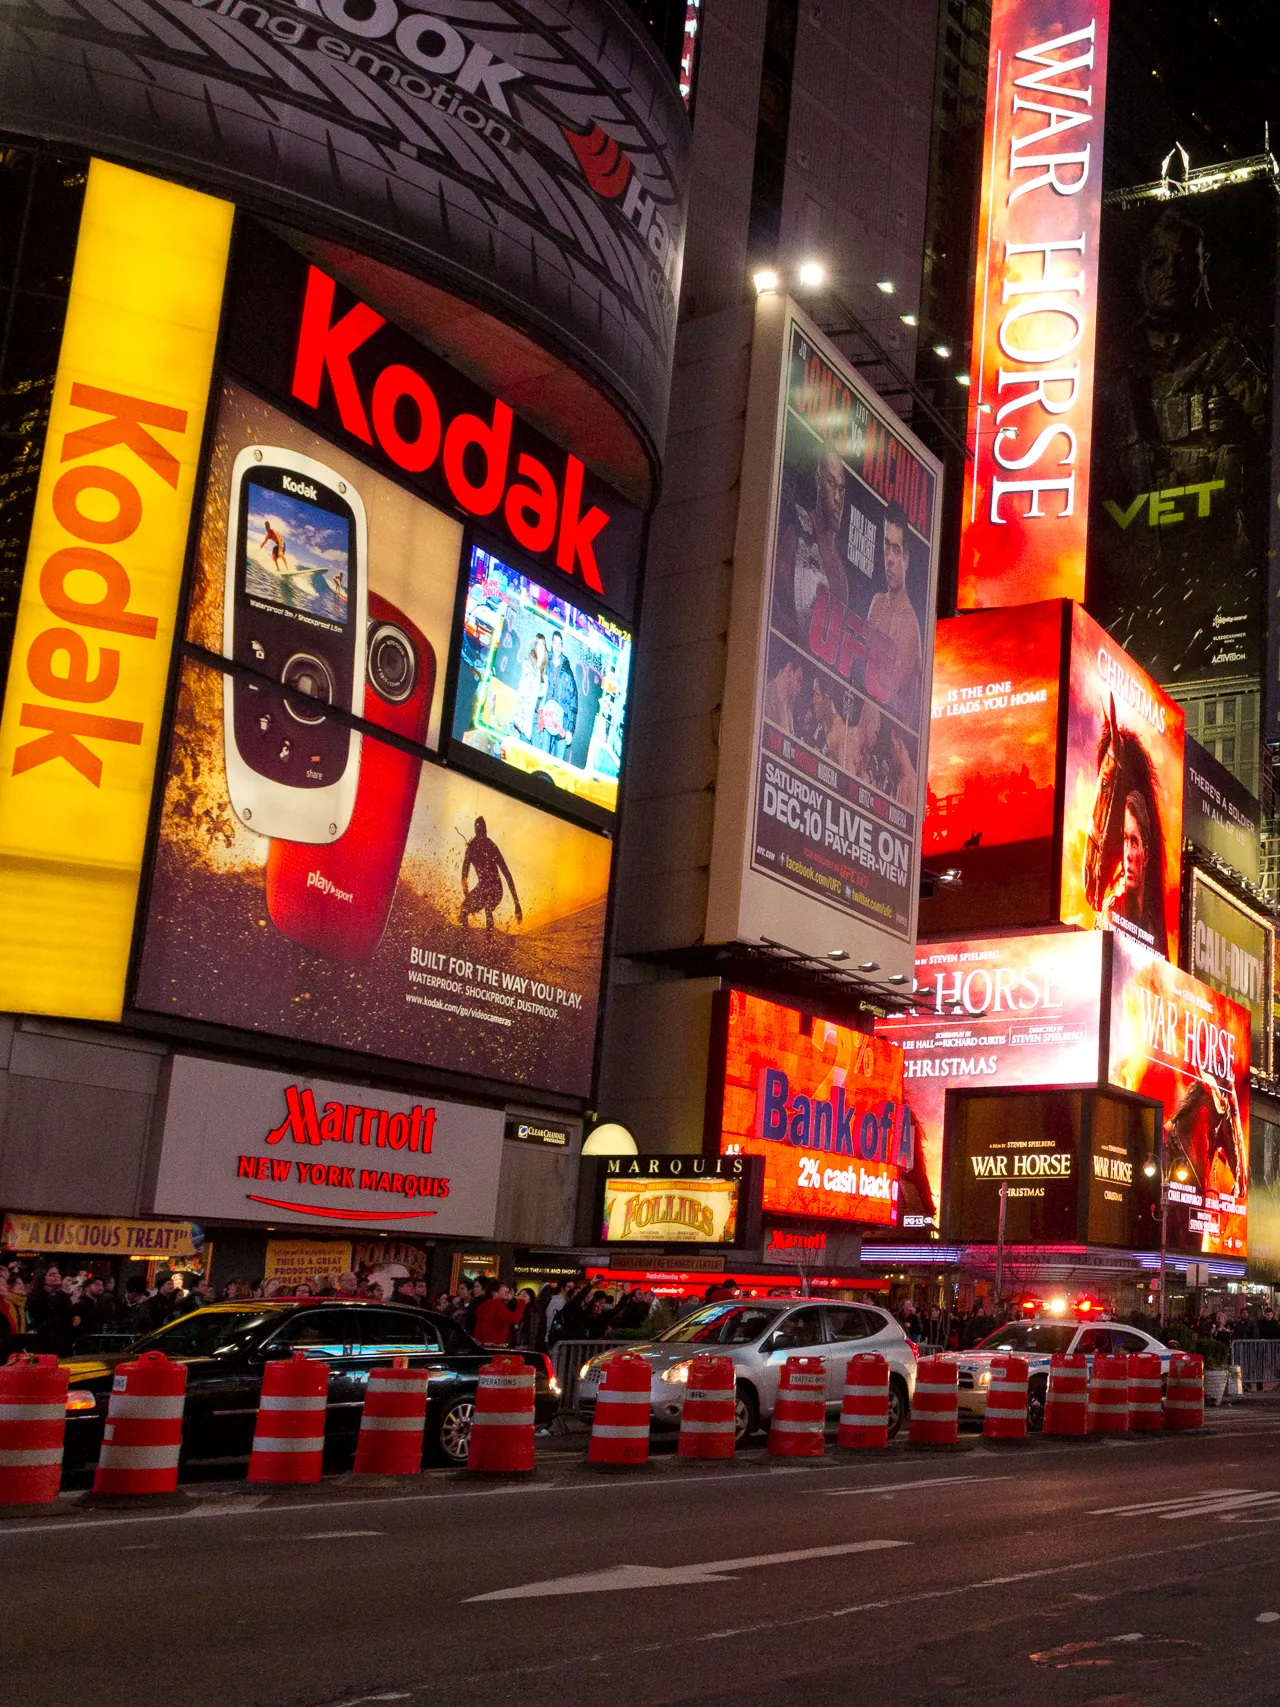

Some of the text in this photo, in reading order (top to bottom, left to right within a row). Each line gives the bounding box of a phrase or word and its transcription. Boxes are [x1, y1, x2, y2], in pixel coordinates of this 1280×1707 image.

[316, 33, 513, 148] emotion
[989, 17, 1097, 524] WAR HORSE
[291, 263, 611, 596] Kodak
[282, 475, 319, 501] Kodak
[1103, 479, 1226, 530] VET
[11, 381, 189, 789] Kodak
[808, 582, 898, 704] UFC
[946, 689, 1047, 717] LEADS YOU HOME
[947, 680, 1012, 702] IS THE ONE
[1097, 648, 1166, 734] CHRISTMAS
[306, 767, 324, 781] share
[764, 761, 824, 812] SATURDAY
[762, 782, 822, 842] DEC.10
[1189, 767, 1256, 836] THERE'S A SOLDIER
[1202, 799, 1246, 847] IN ALL OF US
[825, 798, 873, 852] LIVE
[877, 830, 909, 873] ON
[785, 855, 842, 895] facebook.com/UFC
[824, 829, 908, 889] PAY-PER-VIEW
[306, 869, 354, 904] play sport
[929, 950, 1000, 965] STEVEN SPIELBERG
[1195, 919, 1228, 985] CALL
[407, 969, 560, 1020] WATERPROOF. SHOCKPROOF. DUSTPROOF.
[410, 946, 583, 1010] BUILT FOR THE WAY YOU PLAY.
[934, 965, 1064, 1016] HORSE
[405, 991, 512, 1027] www.kodak.com/go/videocameras
[915, 1039, 935, 1050] HALL
[943, 1037, 978, 1048] RICHARD
[978, 1035, 1006, 1046] CURTIS
[1011, 1034, 1042, 1044] STEVEN
[1139, 987, 1178, 1058] WAR
[1183, 1009, 1236, 1083] HORSE
[264, 1084, 437, 1154] Marriott
[762, 1066, 855, 1157] Bank
[859, 1100, 895, 1163] of
[606, 1159, 743, 1175] MARQUIS
[971, 1153, 1071, 1176] WAR HORSE
[1006, 1141, 1028, 1149] STEVEN
[236, 1155, 450, 1199] NEW YORK MARQUIS
[797, 1156, 891, 1200] 2% cash back
[1093, 1155, 1133, 1183] WAR HORSE
[998, 1187, 1045, 1197] CHRISTMAS
[43, 1222, 121, 1249] LUSCIOUS
[620, 1193, 714, 1240] FOLLIES
[276, 1256, 342, 1266] THIS IS A GREAT
[766, 1229, 827, 1251] Marriott
[274, 1266, 330, 1275] PRODUCTION
[550, 1267, 562, 1275] AND
